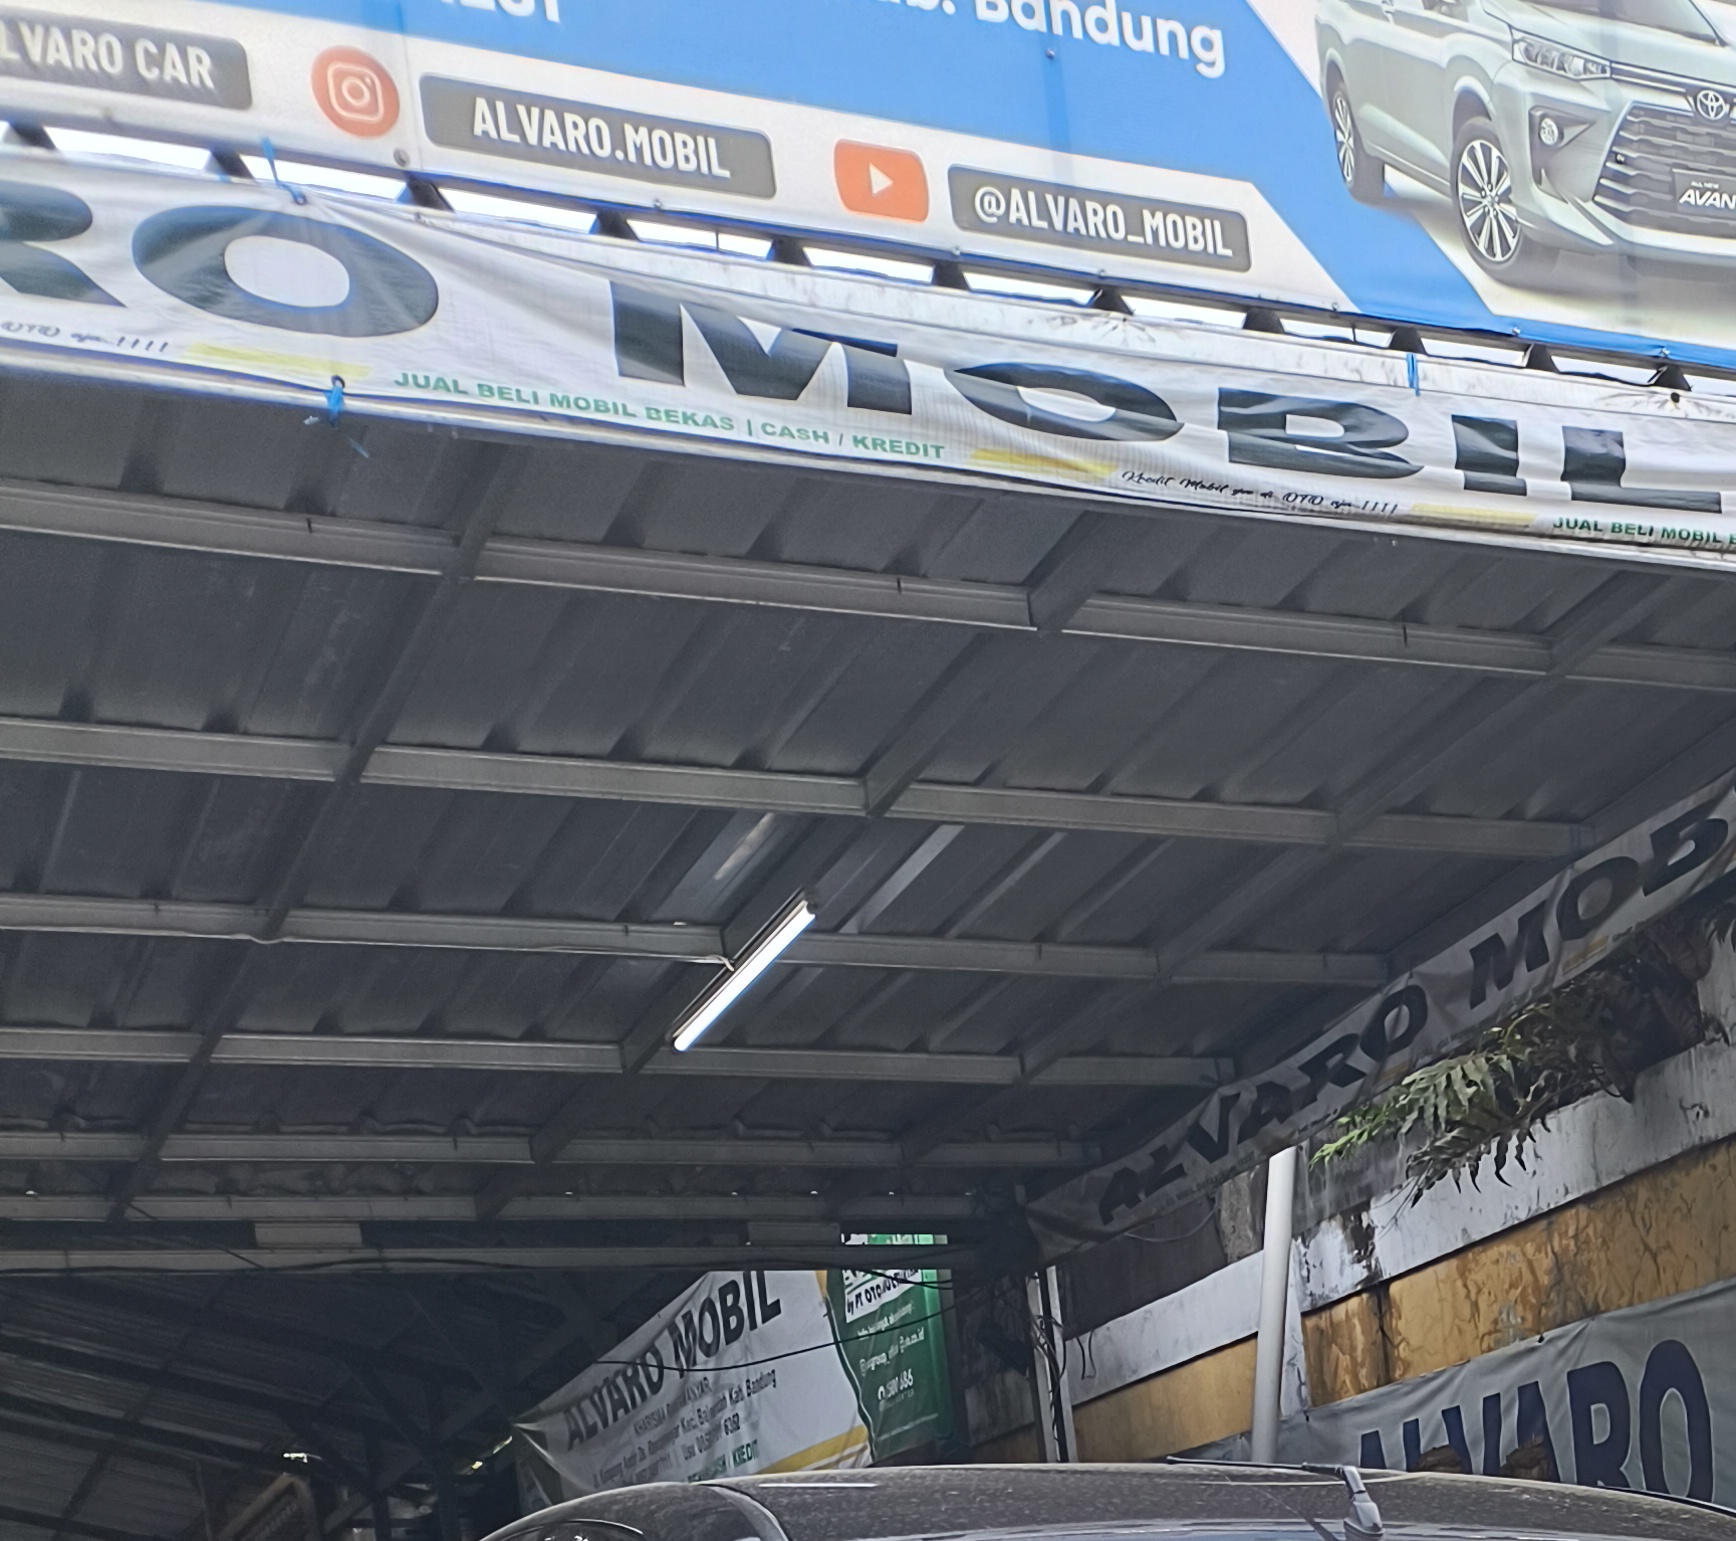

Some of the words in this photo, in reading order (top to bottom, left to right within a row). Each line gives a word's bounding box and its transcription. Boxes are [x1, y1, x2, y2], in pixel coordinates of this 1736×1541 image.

[134, 38, 215, 89] CAR
[473, 97, 731, 179] ALVARO.MOBIL
[974, 185, 1233, 258] @ALVARO_MOBIL
[394, 372, 469, 395] JUAL
[477, 382, 540, 404] BELI
[549, 393, 638, 418] MOBIL
[645, 406, 735, 431] BEKAS
[760, 422, 830, 445] CASH
[852, 434, 946, 459] KREDIT
[608, 279, 1722, 515] MOBIL
[1282, 491, 1324, 505] OTO
[1552, 517, 1604, 533] JUAL
[1611, 522, 1654, 537] BELI
[1661, 527, 1723, 544] MOBIL
[561, 1338, 664, 1451] ALVARO
[667, 1270, 782, 1379] MOBIL
